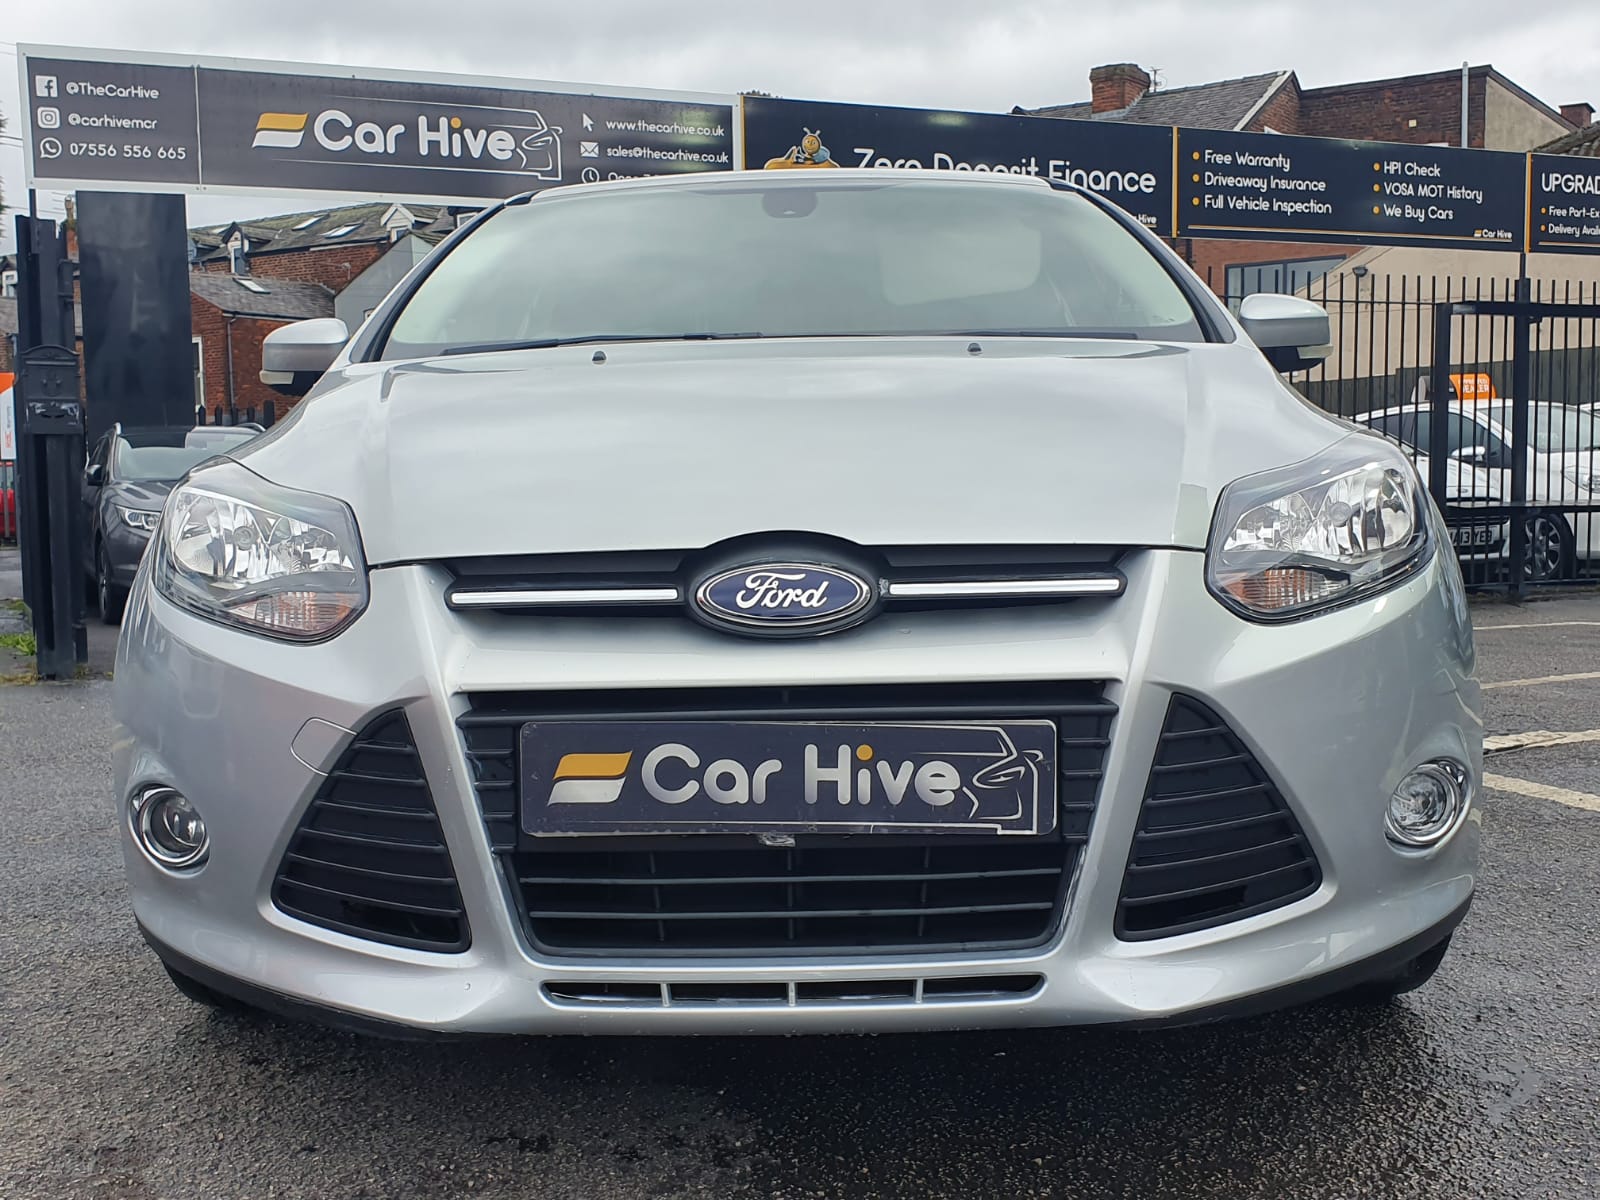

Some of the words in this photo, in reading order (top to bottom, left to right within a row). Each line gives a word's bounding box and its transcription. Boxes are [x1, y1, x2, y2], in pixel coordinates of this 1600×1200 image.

[66, 82, 160, 99] @TheCarHive
[68, 112, 157, 130] @carhivemcr
[606, 120, 724, 136] www.thecarhive.co.uk
[313, 109, 405, 154] Car
[418, 115, 516, 159] Hive
[69, 142, 117, 157] 07556
[122, 143, 152, 159] 556
[157, 145, 186, 160] 665
[607, 145, 728, 163] sales@thecarhive.co.uk
[1204, 149, 1232, 164] Free
[1235, 151, 1290, 172] Warranty
[1383, 160, 1401, 175] HPI
[1404, 163, 1441, 177] Check
[1048, 159, 1156, 193] Finance
[1204, 171, 1267, 192] Driveaway
[1270, 175, 1326, 191] Insurance
[1383, 182, 1414, 196] VOSA
[1417, 184, 1444, 198] MOT
[1447, 186, 1482, 204] History
[1204, 194, 1223, 209] Full
[1227, 195, 1270, 211] Vehicle
[1273, 198, 1332, 216] Inspection
[1383, 204, 1402, 217] We
[1405, 205, 1425, 222] Buy
[1428, 206, 1453, 220] Cars
[1548, 206, 1567, 216] Free
[1482, 229, 1496, 238] Car
[1497, 229, 1512, 239] Hive
[1548, 223, 1580, 237] Delivery
[735, 572, 828, 610] Ford
[641, 743, 782, 805] Car
[804, 743, 961, 806] Hive
